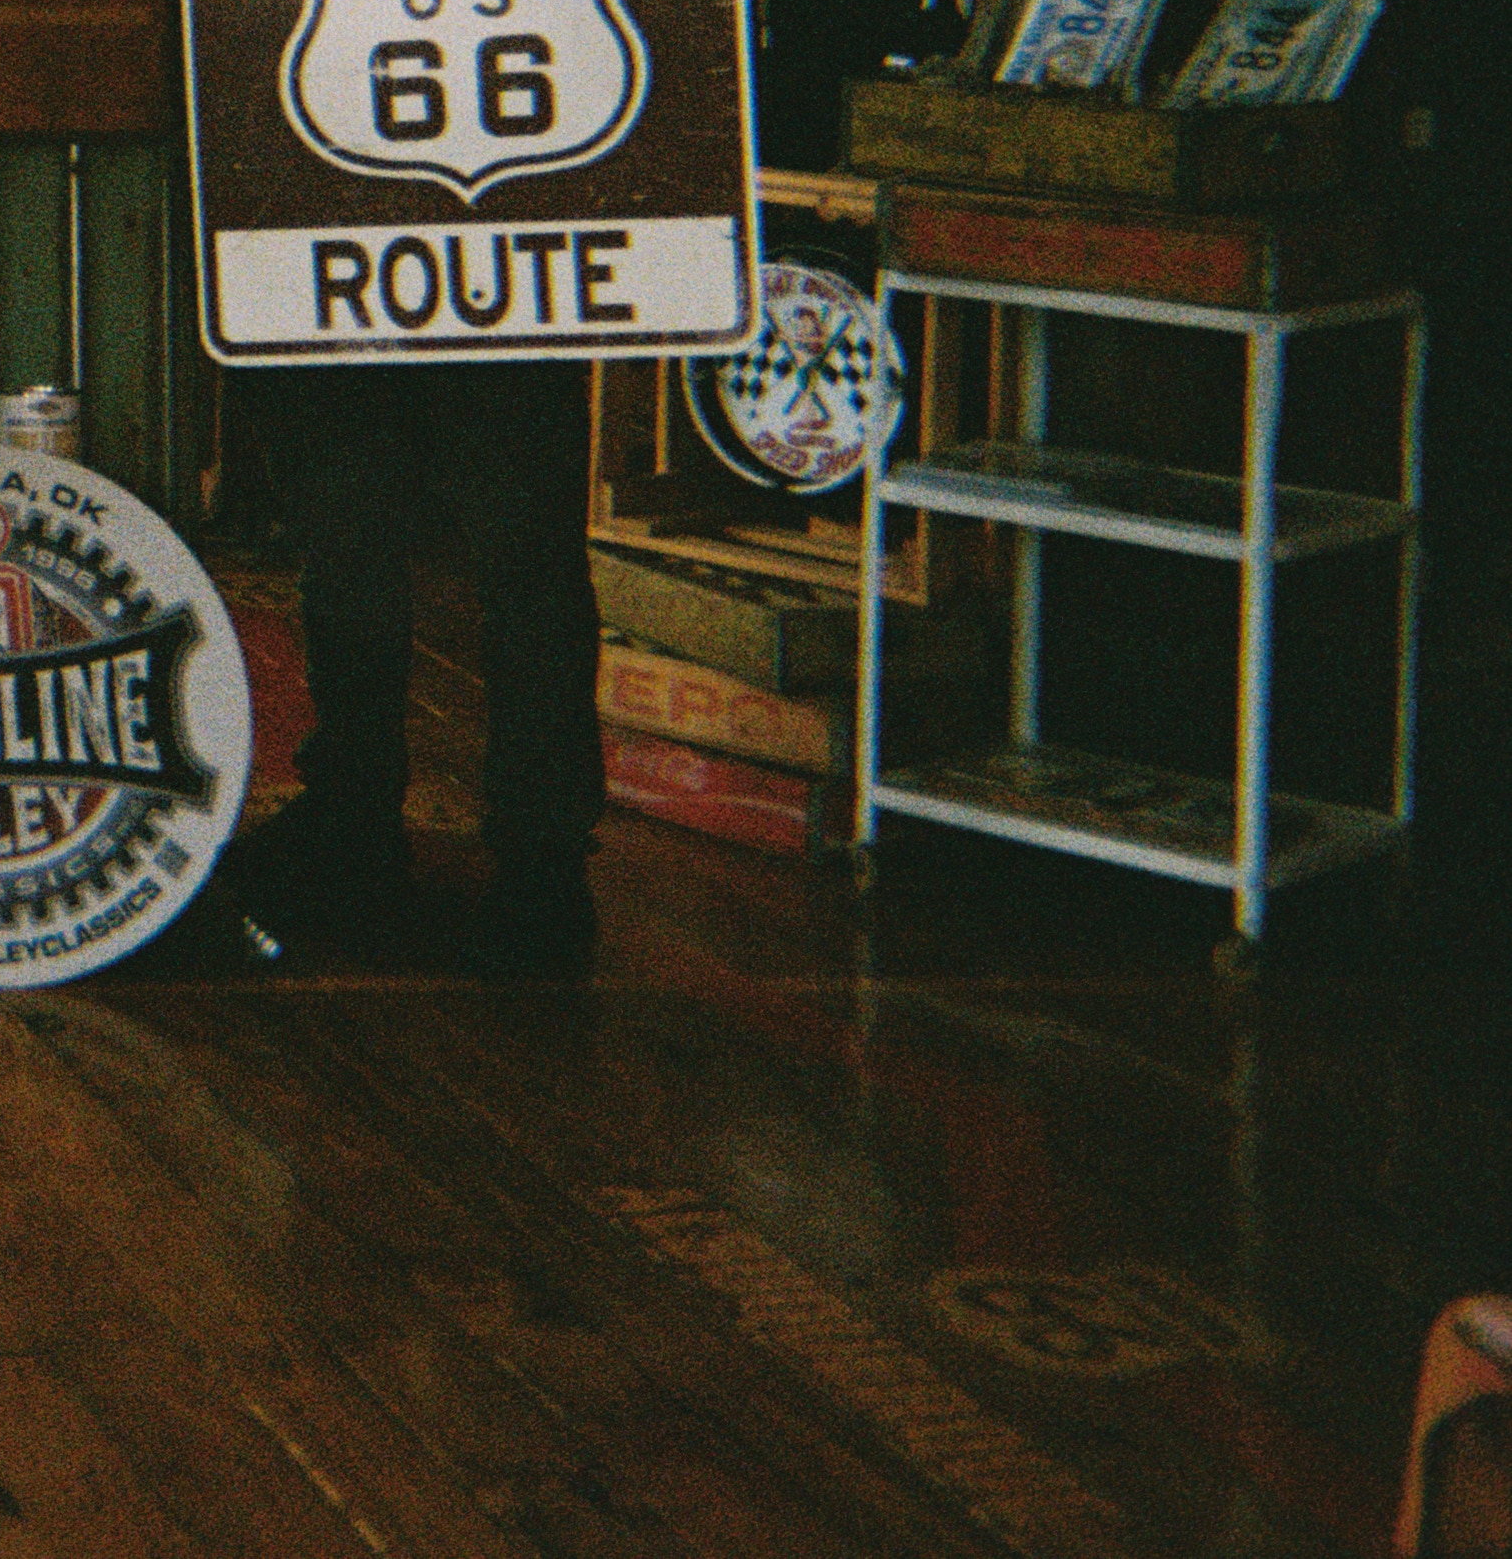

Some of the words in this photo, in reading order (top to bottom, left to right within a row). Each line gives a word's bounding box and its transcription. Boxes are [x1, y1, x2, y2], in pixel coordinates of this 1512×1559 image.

[367, 32, 559, 142] 66
[312, 229, 636, 332] ROUTE
[49, 483, 111, 527] OK
